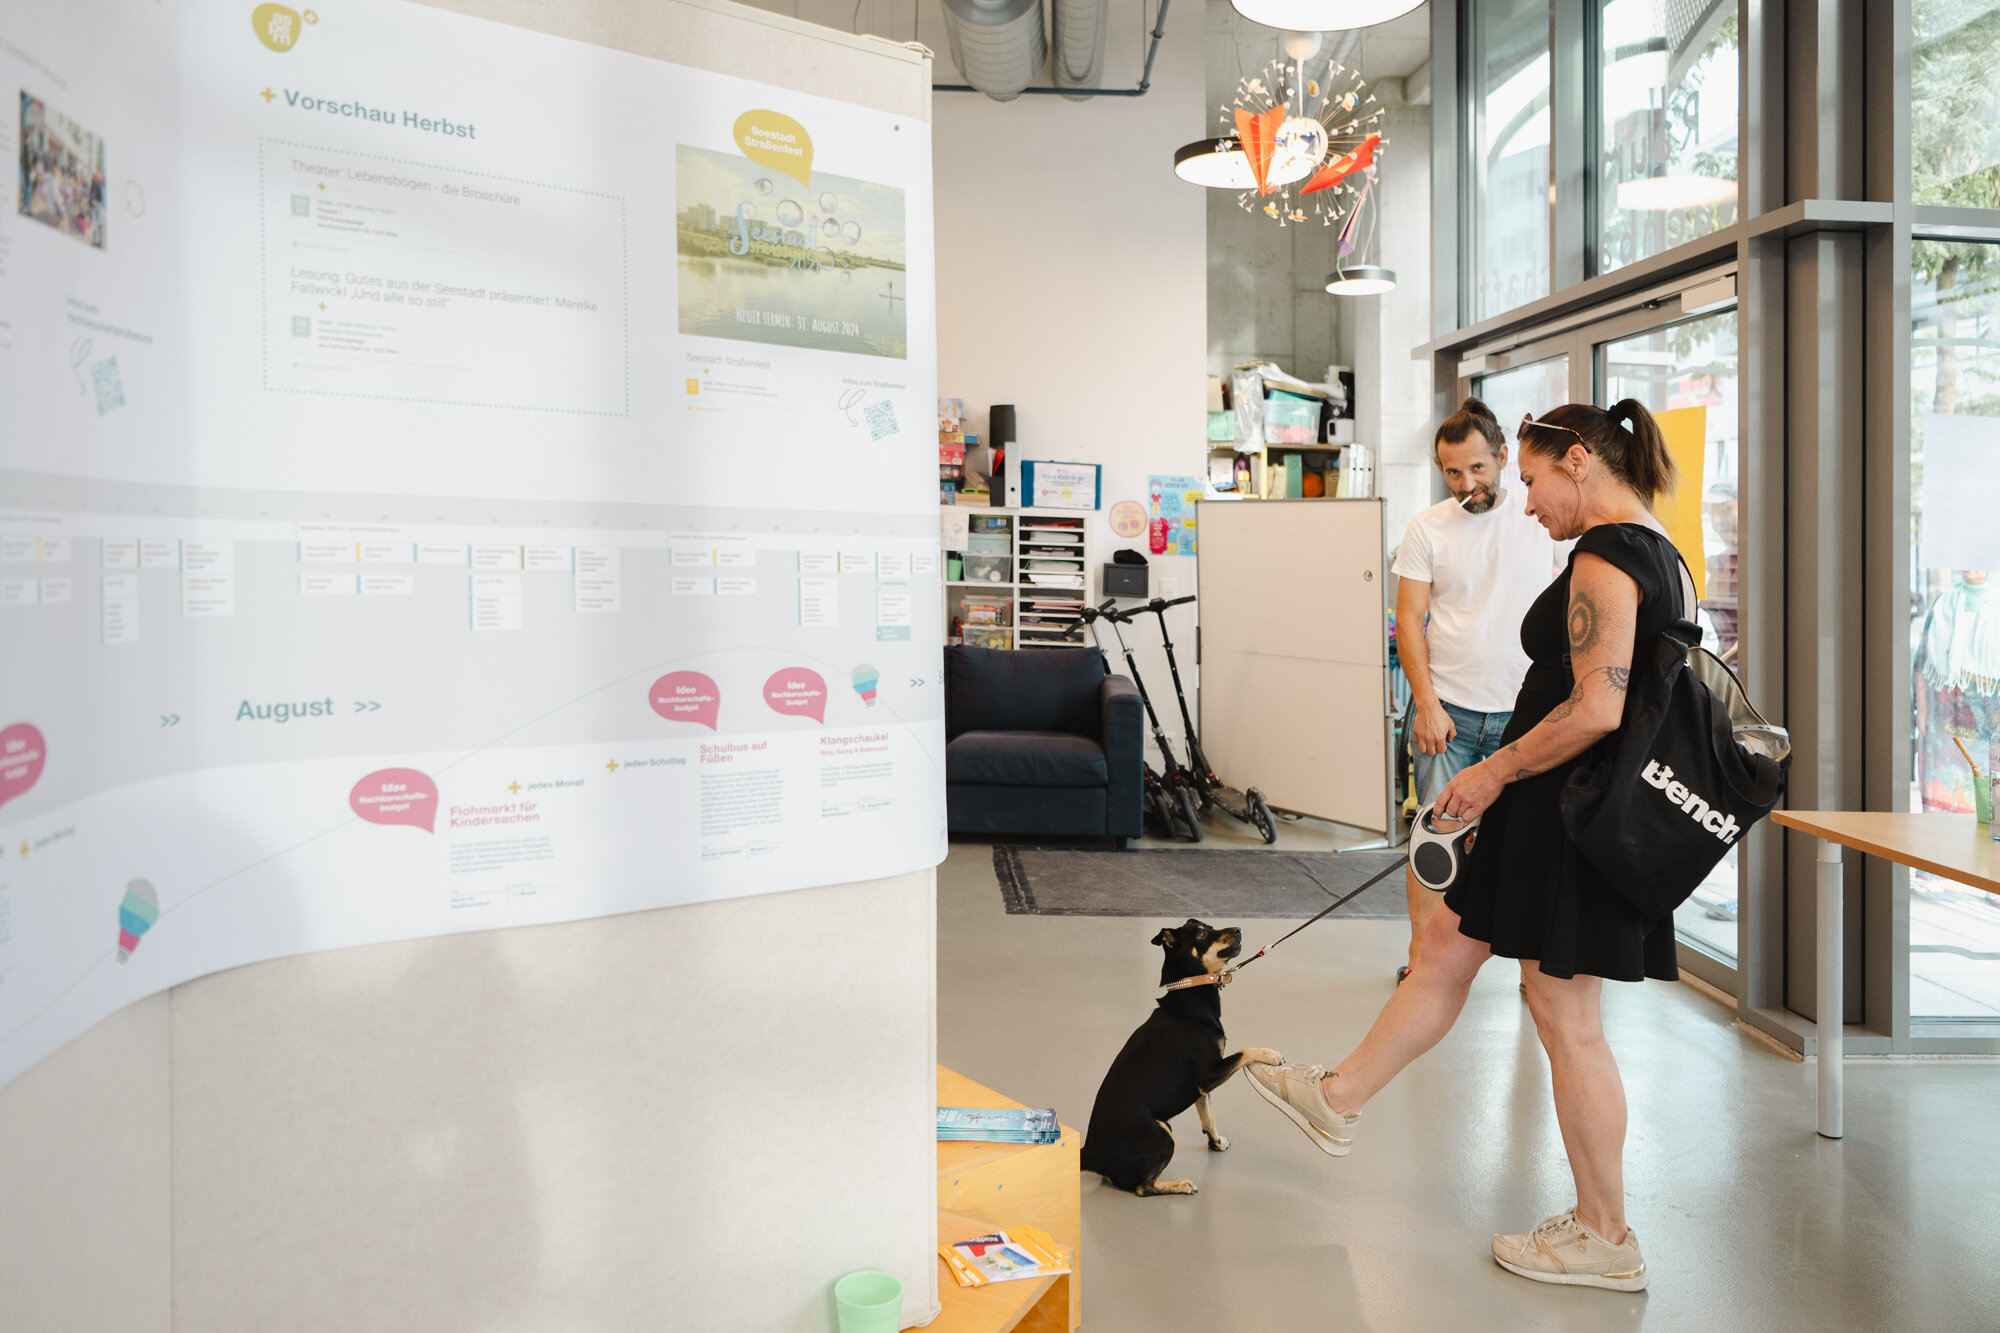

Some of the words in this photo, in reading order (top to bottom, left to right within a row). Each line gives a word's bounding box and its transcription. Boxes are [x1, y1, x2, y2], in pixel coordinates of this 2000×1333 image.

[284, 88, 396, 124] Vorschau
[403, 110, 476, 140] Herbst
[751, 125, 796, 144] Seestadt
[744, 136, 803, 157] Straßenfest
[348, 168, 431, 193] Lebensbögen
[442, 184, 459, 197] die
[462, 186, 521, 206] Broschüre
[291, 280, 347, 298] Fallwickl
[383, 290, 405, 304] alle
[408, 296, 423, 307] so
[345, 272, 383, 288] Gutes
[386, 278, 409, 290] aus
[412, 280, 431, 293] der
[434, 283, 486, 299] Seestadt
[555, 297, 598, 312] Mareike
[736, 308, 761, 325] NEUER
[812, 318, 840, 335] AUGUST
[841, 320, 859, 337] 2024
[676, 686, 697, 695] Idee
[787, 681, 806, 690] Idee
[674, 704, 699, 713] budget
[785, 698, 808, 707] budget
[236, 697, 334, 723] August
[820, 732, 889, 746] Klangschaukel
[700, 743, 749, 754] Schulbus
[751, 740, 768, 751] auf
[624, 759, 648, 769] jeden
[649, 757, 687, 766] Schultag
[700, 753, 734, 764] Füßen
[382, 782, 407, 793] Idee
[527, 781, 554, 791] jedes
[555, 778, 585, 788] Monat
[450, 803, 516, 816] Flohmarkt
[520, 801, 538, 812] für
[450, 813, 540, 828] Kindersachen
